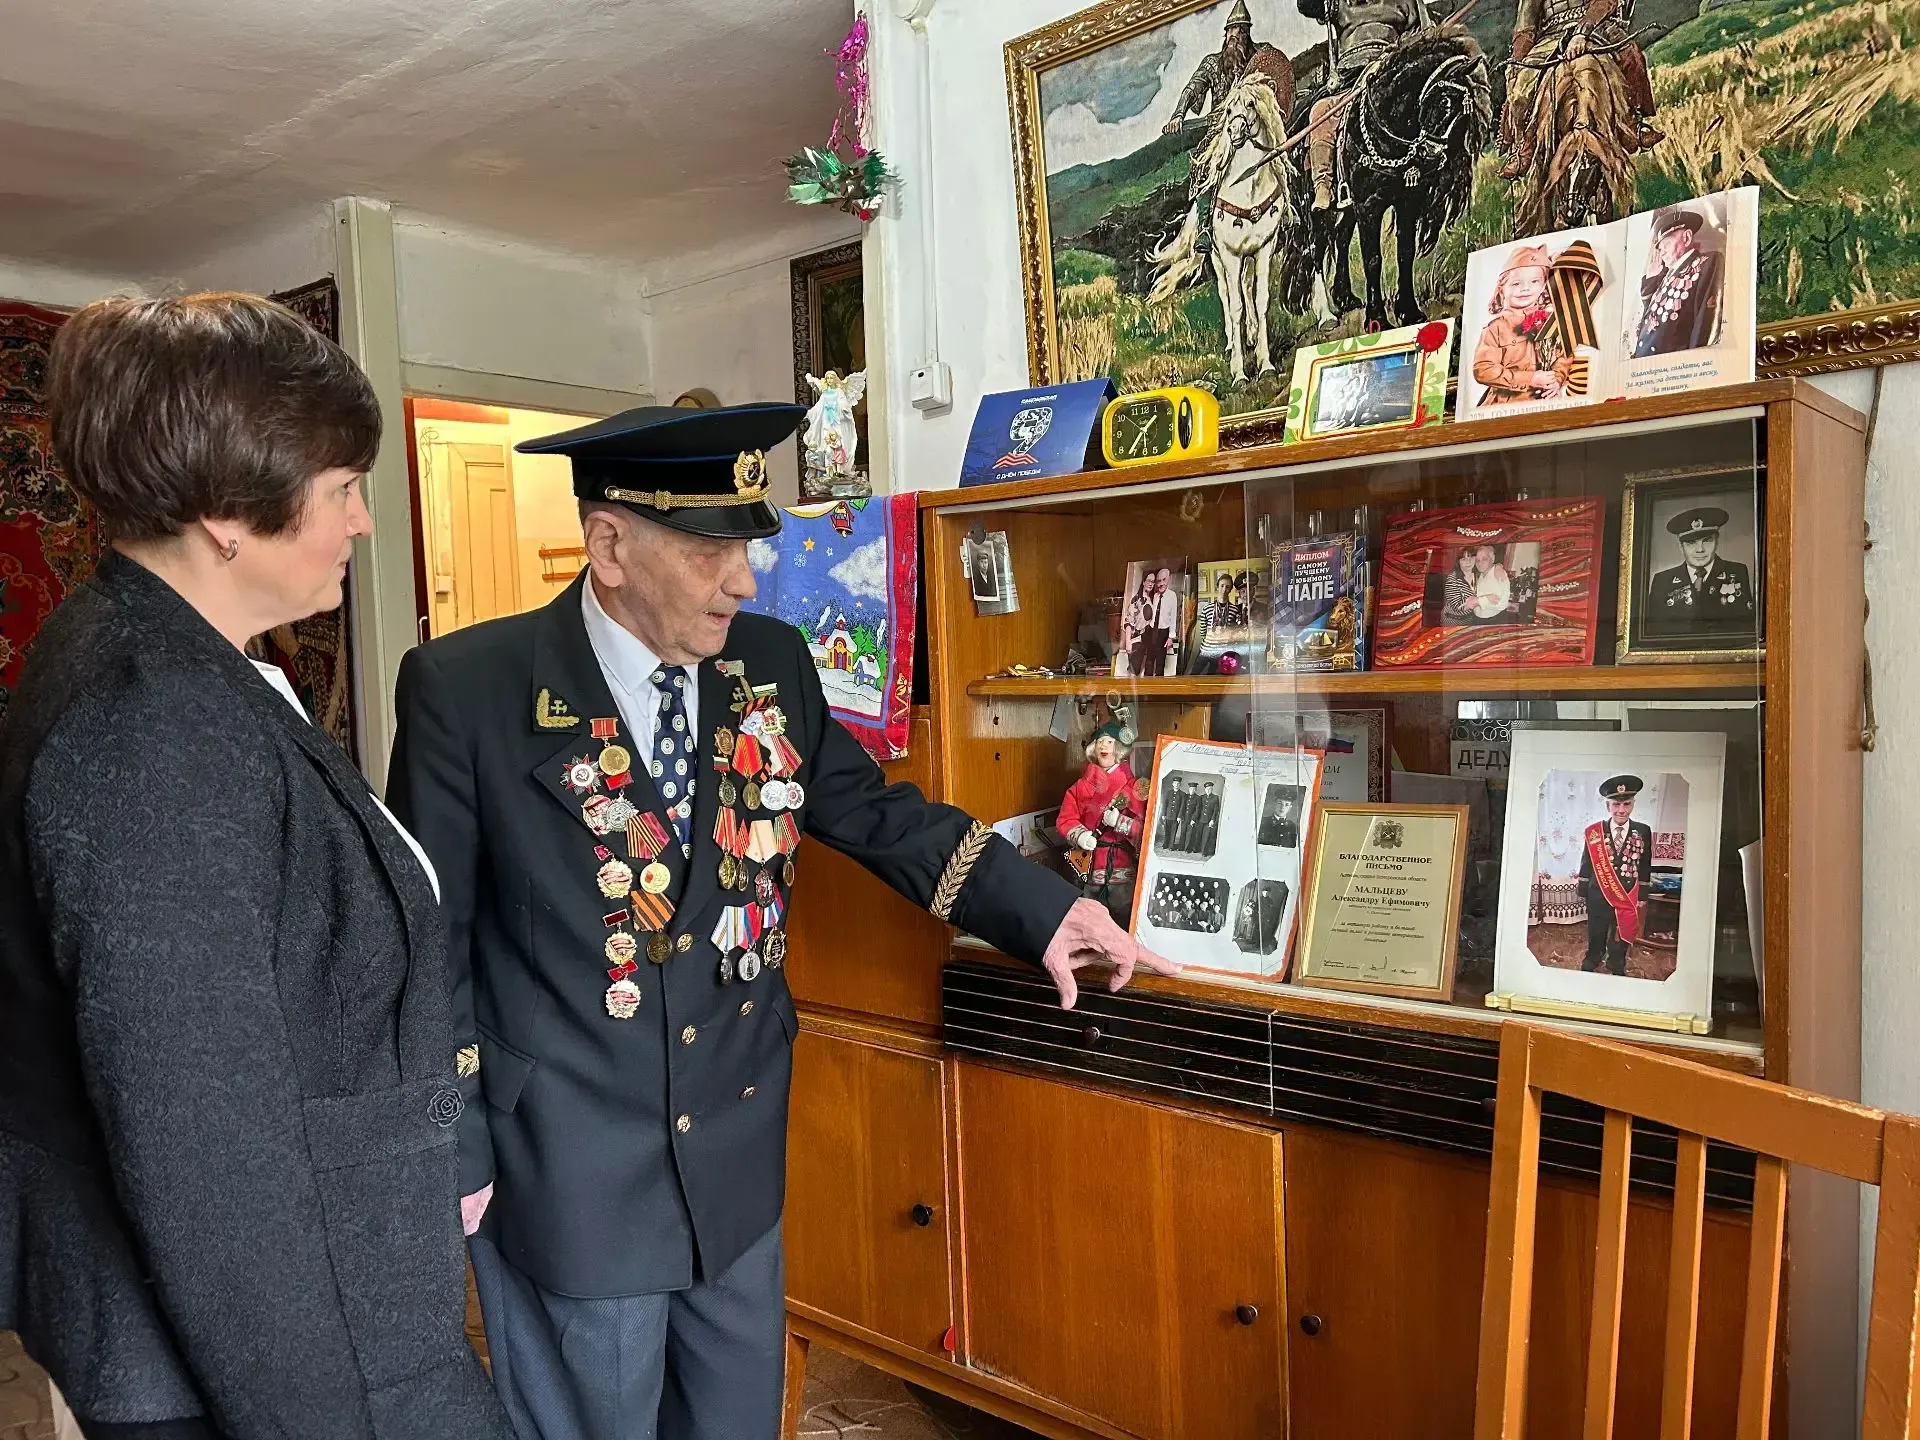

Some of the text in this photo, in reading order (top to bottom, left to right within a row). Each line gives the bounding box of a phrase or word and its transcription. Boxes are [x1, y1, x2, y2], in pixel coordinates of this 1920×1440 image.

[1665, 373, 1693, 382] детство
[1131, 407, 1138, 416] 11
[1140, 405, 1150, 415] 12
[1153, 404, 1158, 412] 1
[1166, 407, 1172, 416] 2
[1117, 414, 1126, 423] 10
[1168, 423, 1174, 431] 3
[1116, 430, 1122, 438] 9
[1118, 446, 1124, 454] 8
[1152, 446, 1158, 454] 5
[1294, 551, 1329, 561] ДИПЛОМ
[1297, 561, 1328, 570] САМОМУ
[1290, 574, 1332, 584] ЛЮБИМОМУ
[1287, 580, 1334, 602] ПАПЕ
[1339, 853, 1433, 864] БЛАГОДАРСТВЕННОЕ
[1365, 862, 1403, 871] ПИСЬМО
[1354, 885, 1408, 896] МАЛЬЦЕВУ
[1331, 894, 1379, 905] Александру
[1381, 896, 1431, 908] Ефимовичу
